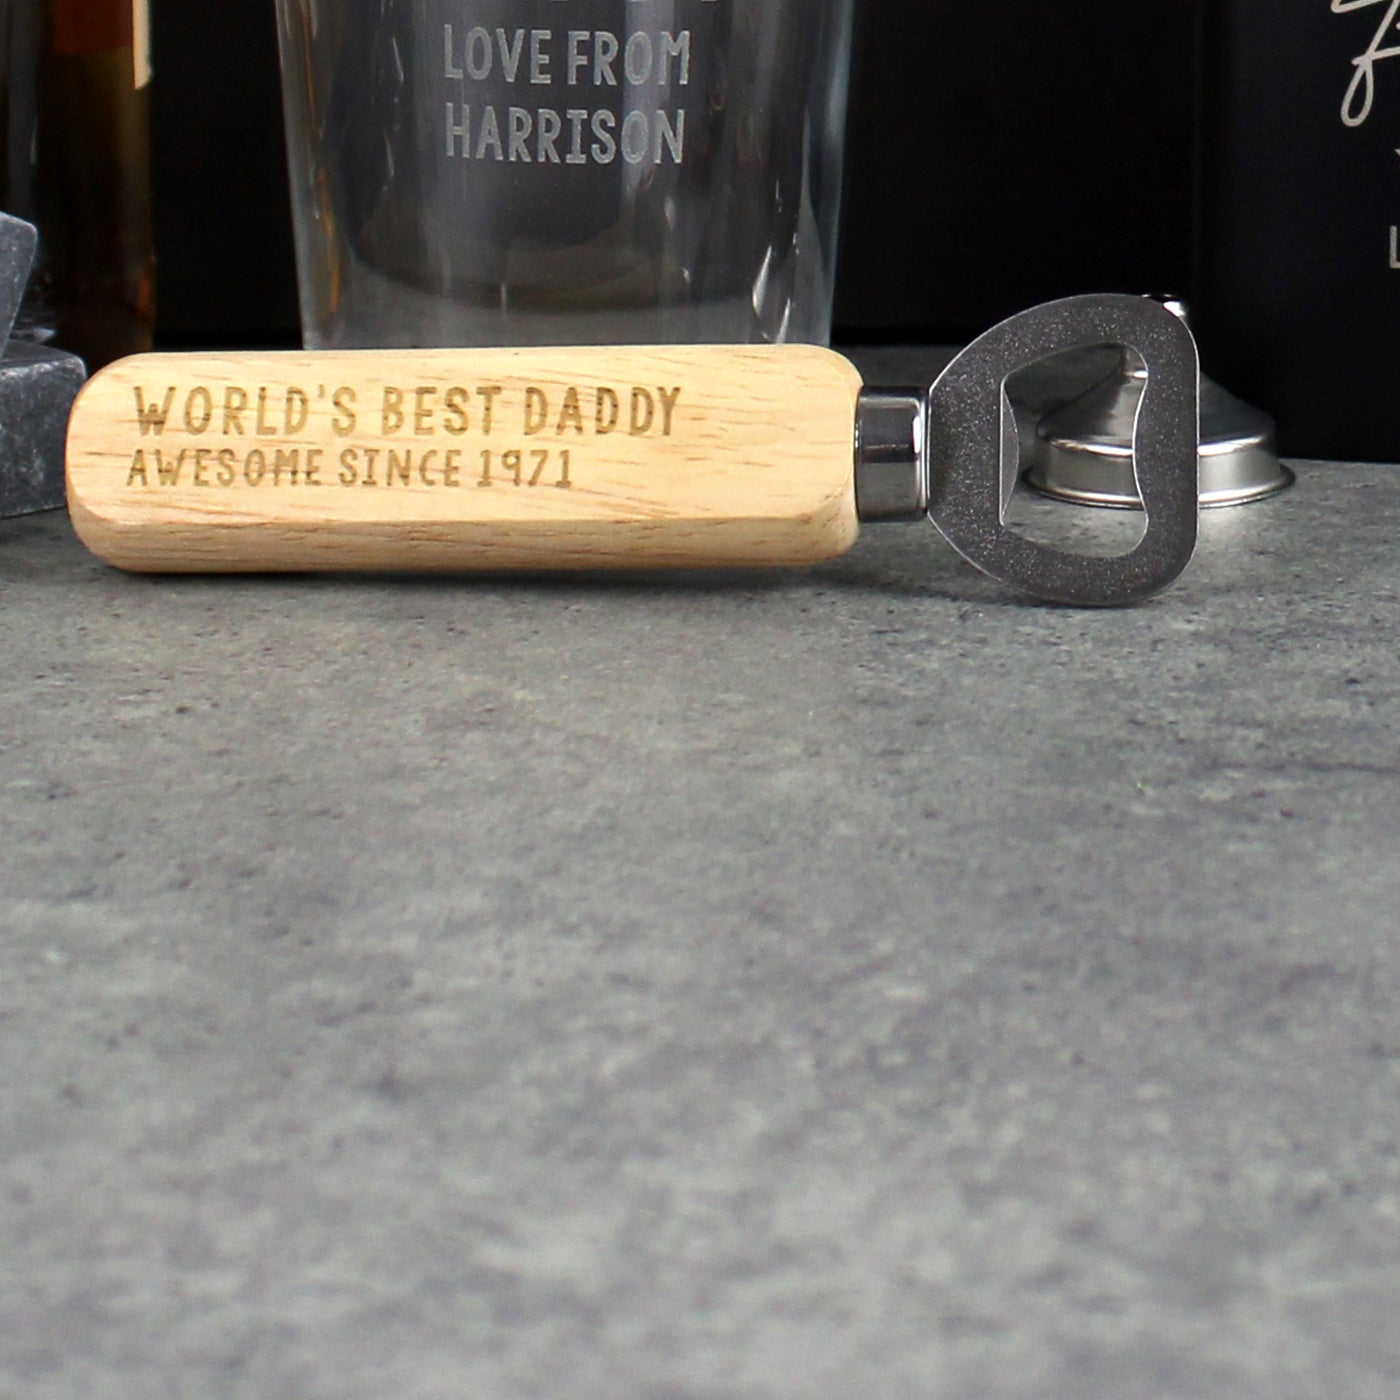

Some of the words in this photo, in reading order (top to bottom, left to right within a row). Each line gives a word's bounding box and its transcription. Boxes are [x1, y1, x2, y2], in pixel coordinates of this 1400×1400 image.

[443, 24, 551, 84] LOVE
[567, 30, 690, 86] FROM
[445, 102, 684, 164] HARRISON
[134, 385, 358, 437] WORLD'S
[381, 386, 501, 437] BEST
[523, 386, 682, 437] DADDY
[127, 448, 323, 487] AWESOME
[338, 449, 461, 487] SINCE
[477, 450, 572, 489] 1971
